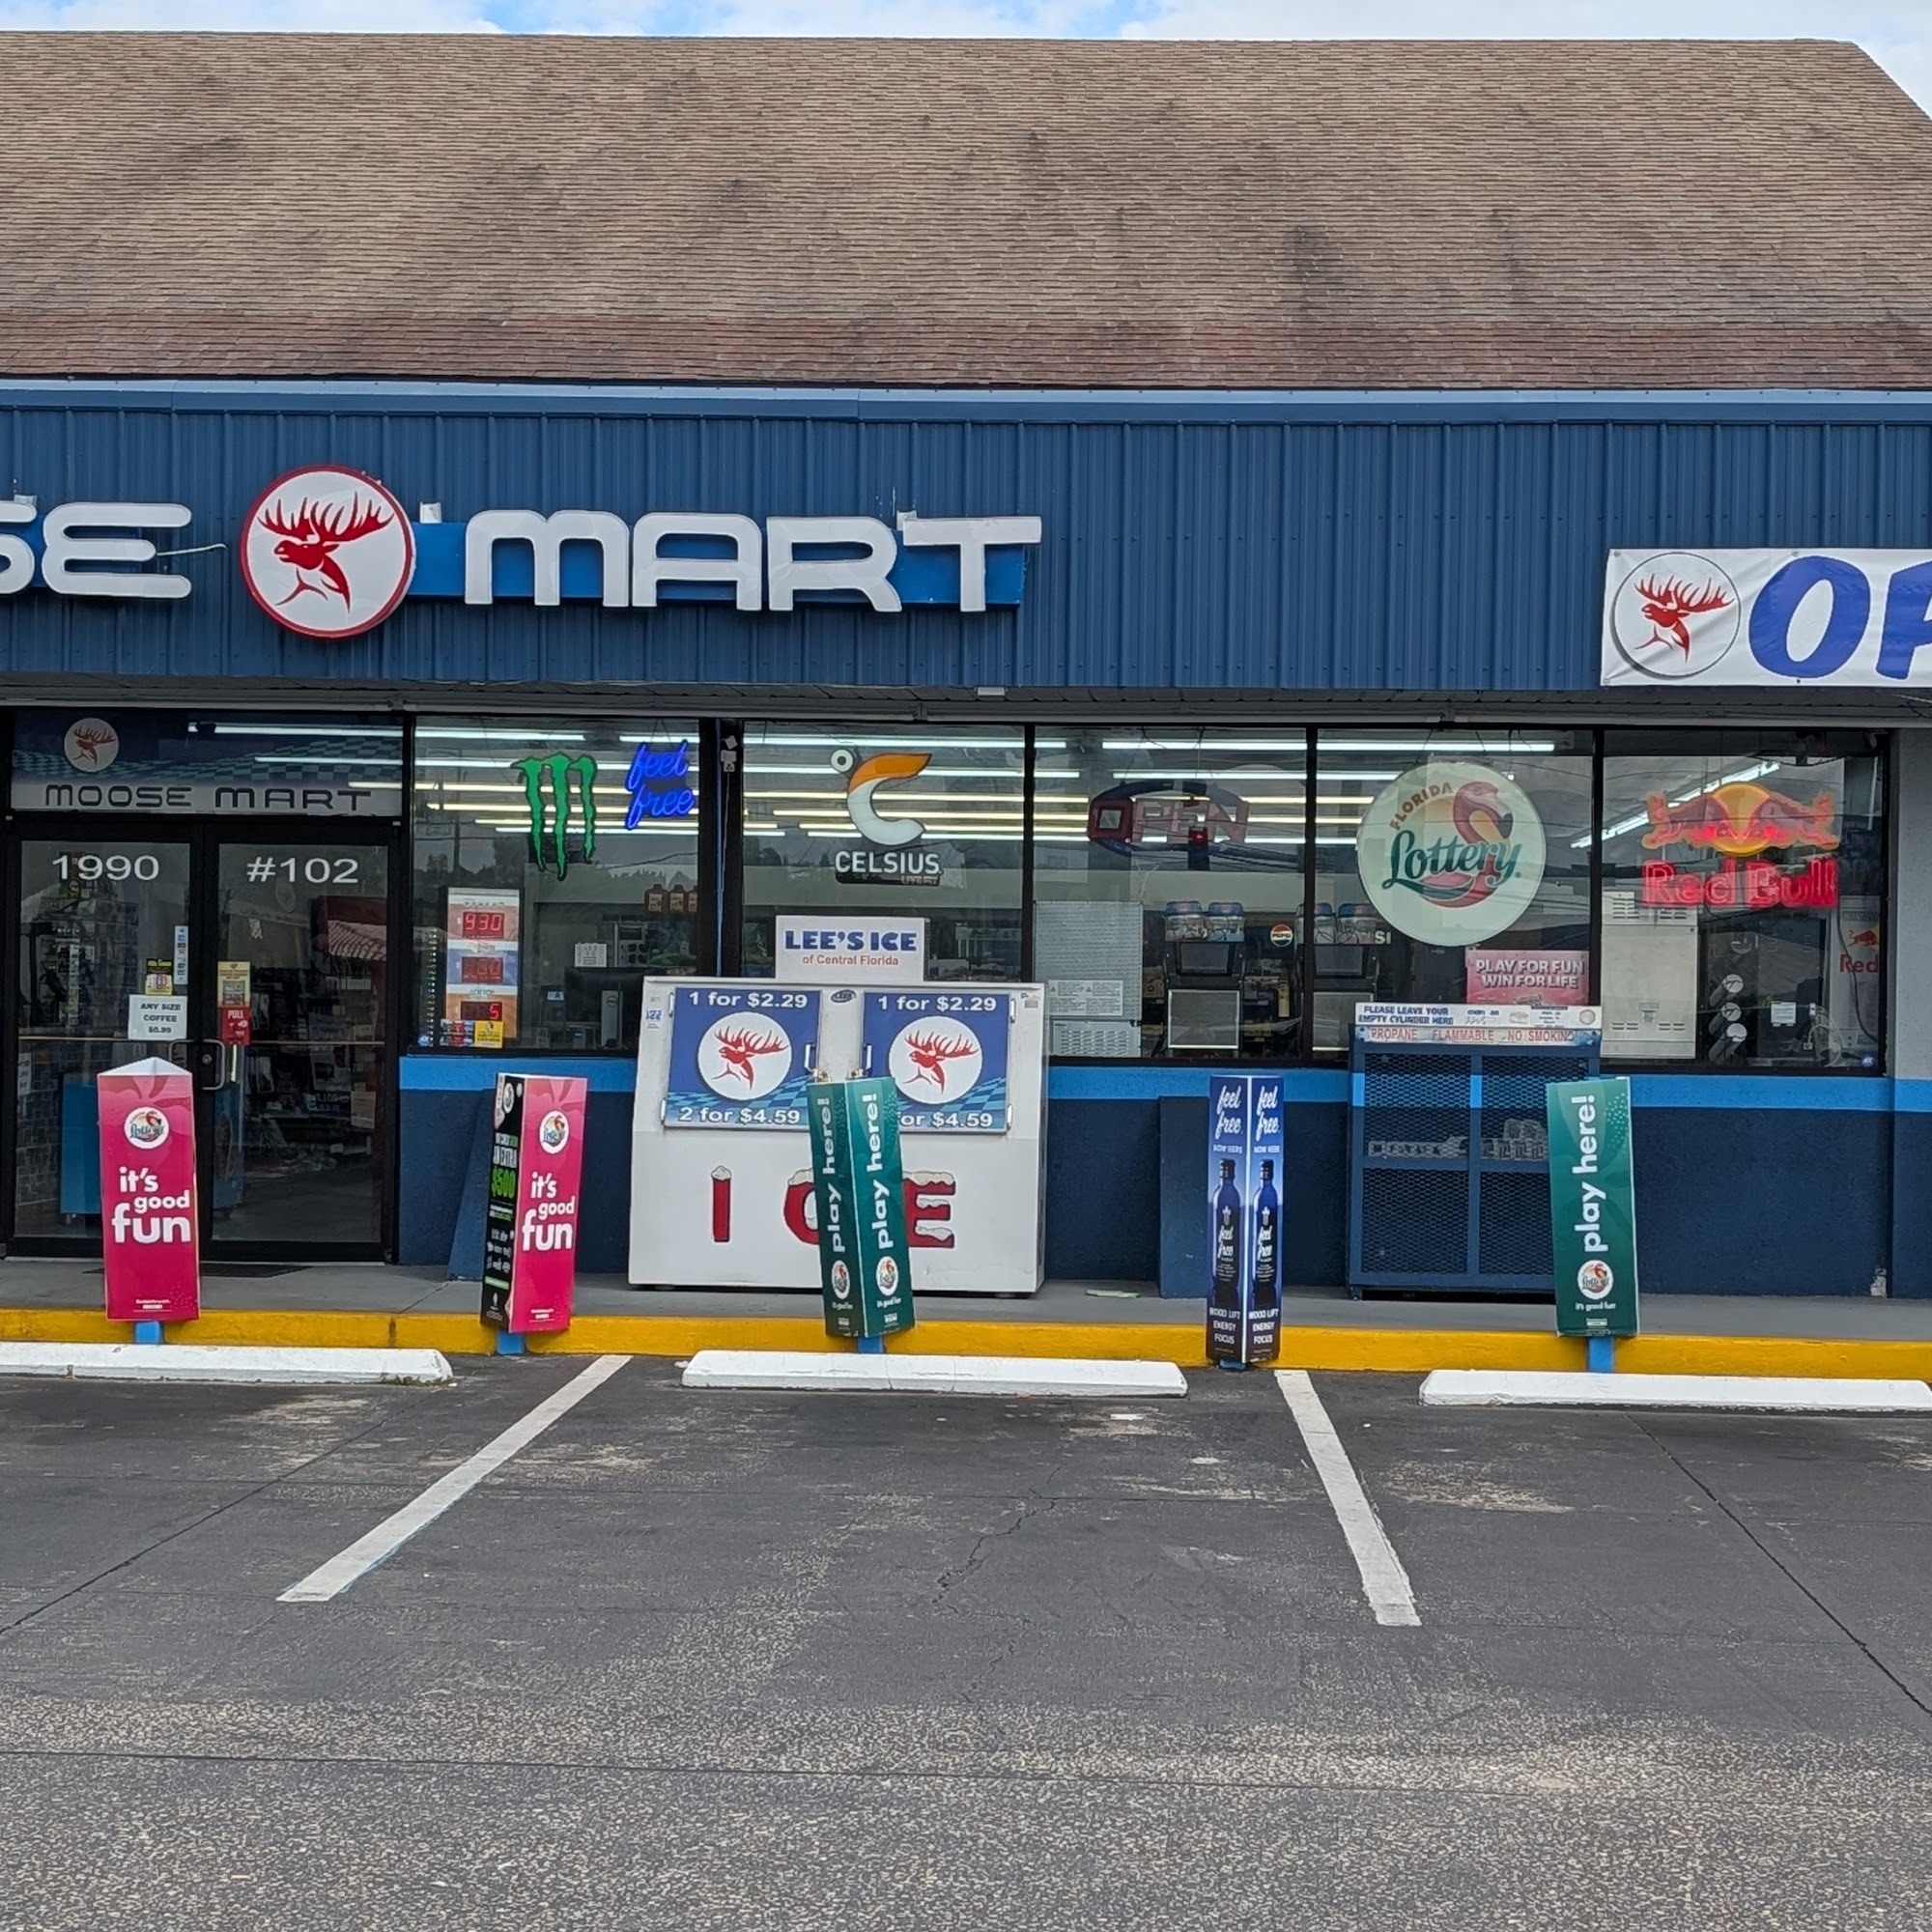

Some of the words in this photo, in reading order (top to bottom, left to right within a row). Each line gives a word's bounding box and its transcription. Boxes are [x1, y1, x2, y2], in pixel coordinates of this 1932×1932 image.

[0, 500, 191, 599] E
[465, 509, 1042, 612] MART
[625, 739, 689, 790] feel
[45, 784, 192, 808] MOOSE
[214, 787, 372, 811] MART
[625, 783, 696, 830] free
[1389, 781, 1453, 831] FLORIDA
[51, 854, 160, 881] 1990
[246, 856, 359, 884] #102
[835, 851, 941, 875] CELSIUS
[1381, 829, 1522, 890] Lottery
[1642, 858, 1737, 907] Red
[1746, 857, 1838, 907] Bull
[784, 930, 865, 951] LEE'S
[869, 932, 917, 952] ICE
[803, 954, 814, 965] of
[816, 954, 858, 965] Central
[860, 955, 899, 966] Florida
[1476, 959, 1516, 975] PLAY
[1518, 959, 1551, 975] FOR
[1551, 960, 1585, 975] FUN
[1839, 953, 1880, 973] Red
[1481, 975, 1515, 988] WIN
[1515, 975, 1548, 988] FOR
[1548, 976, 1578, 989] LIFE
[689, 992, 699, 1006] 1
[708, 992, 741, 1006] for
[747, 992, 809, 1009] $2.29
[877, 996, 887, 1009] 1
[896, 996, 929, 1010] for
[936, 996, 997, 1012] $2.29
[1363, 1006, 1395, 1014] PLEASE
[1397, 1007, 1423, 1015] LEAVE
[143, 1014, 177, 1023] COFFEE
[1358, 1014, 1386, 1023] EMPTY
[1389, 1015, 1430, 1024] CYLINDER
[1370, 1027, 1418, 1040] PROPANE
[1433, 1029, 1494, 1041] FLAMMABLE
[1507, 1030, 1523, 1041] NO
[1216, 1085, 1242, 1115] feel
[1256, 1085, 1278, 1116] feel
[678, 1107, 693, 1122] 2
[700, 1107, 733, 1123] for
[739, 1108, 801, 1124] $4.59
[897, 1111, 925, 1125] or
[931, 1111, 993, 1128] $4.59
[1214, 1110, 1242, 1140] free
[1256, 1111, 1279, 1142] free
[817, 1097, 836, 1175] here!
[862, 1093, 883, 1172] here!
[1571, 1094, 1598, 1175] here!
[119, 1166, 158, 1193] it's
[530, 1172, 557, 1199] it's
[133, 1189, 190, 1214] good
[539, 1195, 576, 1221] good
[871, 1179, 895, 1249] play
[111, 1203, 191, 1243] fun
[827, 1181, 846, 1253] play
[1575, 1181, 1608, 1252] play
[522, 1209, 573, 1252] fun
